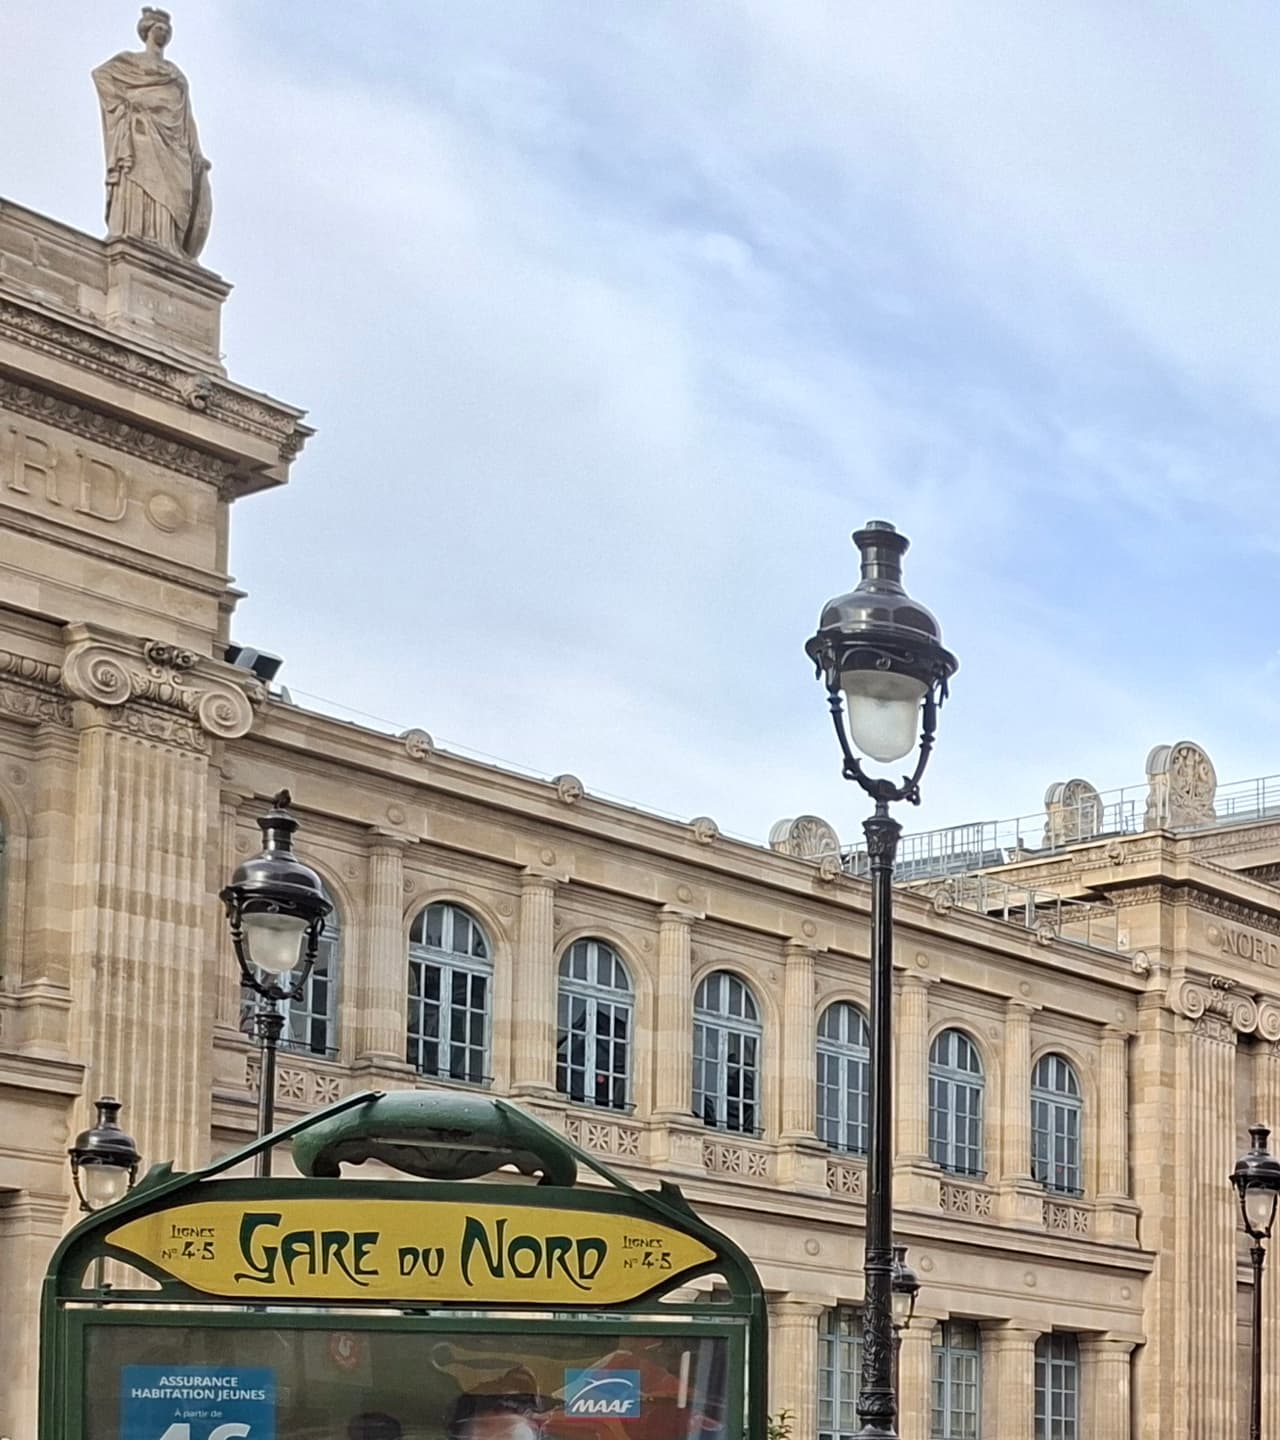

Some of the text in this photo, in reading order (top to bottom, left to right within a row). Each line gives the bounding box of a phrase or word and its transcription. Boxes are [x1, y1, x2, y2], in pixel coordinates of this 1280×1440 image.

[1220, 927, 1279, 969] NORD
[234, 1212, 608, 1290] GARE DU NORD
[159, 1376, 238, 1387] ASSURANCE
[131, 1388, 265, 1401] HABITATION JEUNES
[183, 1409, 208, 1418] partir
[210, 1409, 223, 1417] de
[571, 1399, 634, 1414] MAAF
